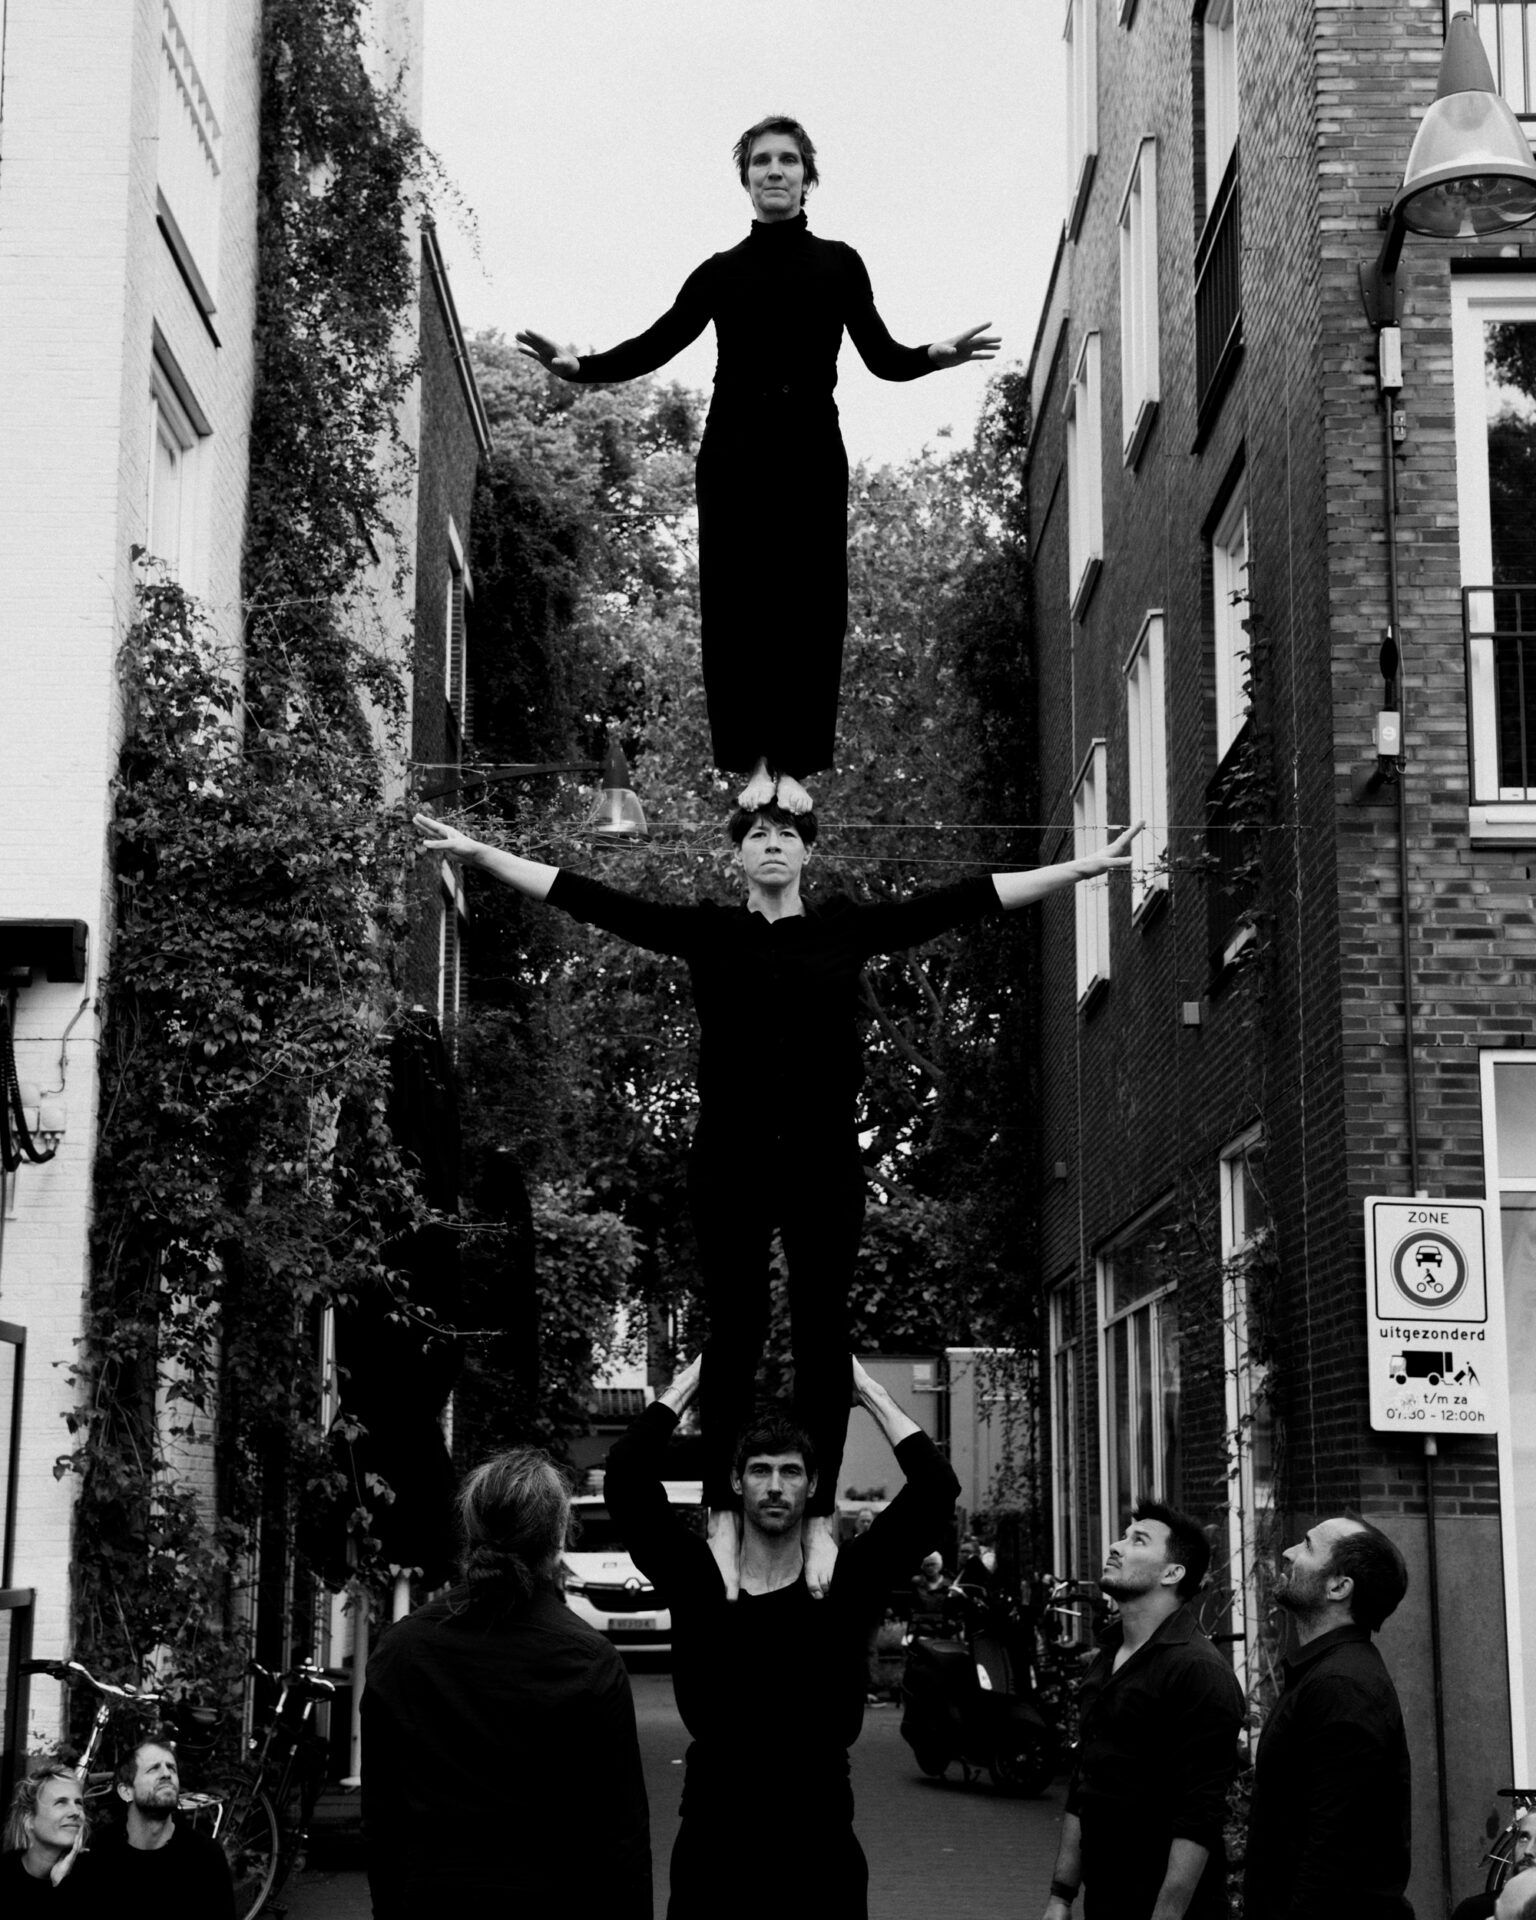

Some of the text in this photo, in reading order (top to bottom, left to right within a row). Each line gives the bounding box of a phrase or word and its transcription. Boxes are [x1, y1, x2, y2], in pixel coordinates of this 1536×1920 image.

[1408, 1211, 1449, 1224] ZONE
[1380, 1326, 1485, 1343] uitgezonderd
[1423, 1392, 1448, 1404] t/m
[1453, 1396, 1468, 1405] za
[1441, 1409, 1485, 1421] 12:00h
